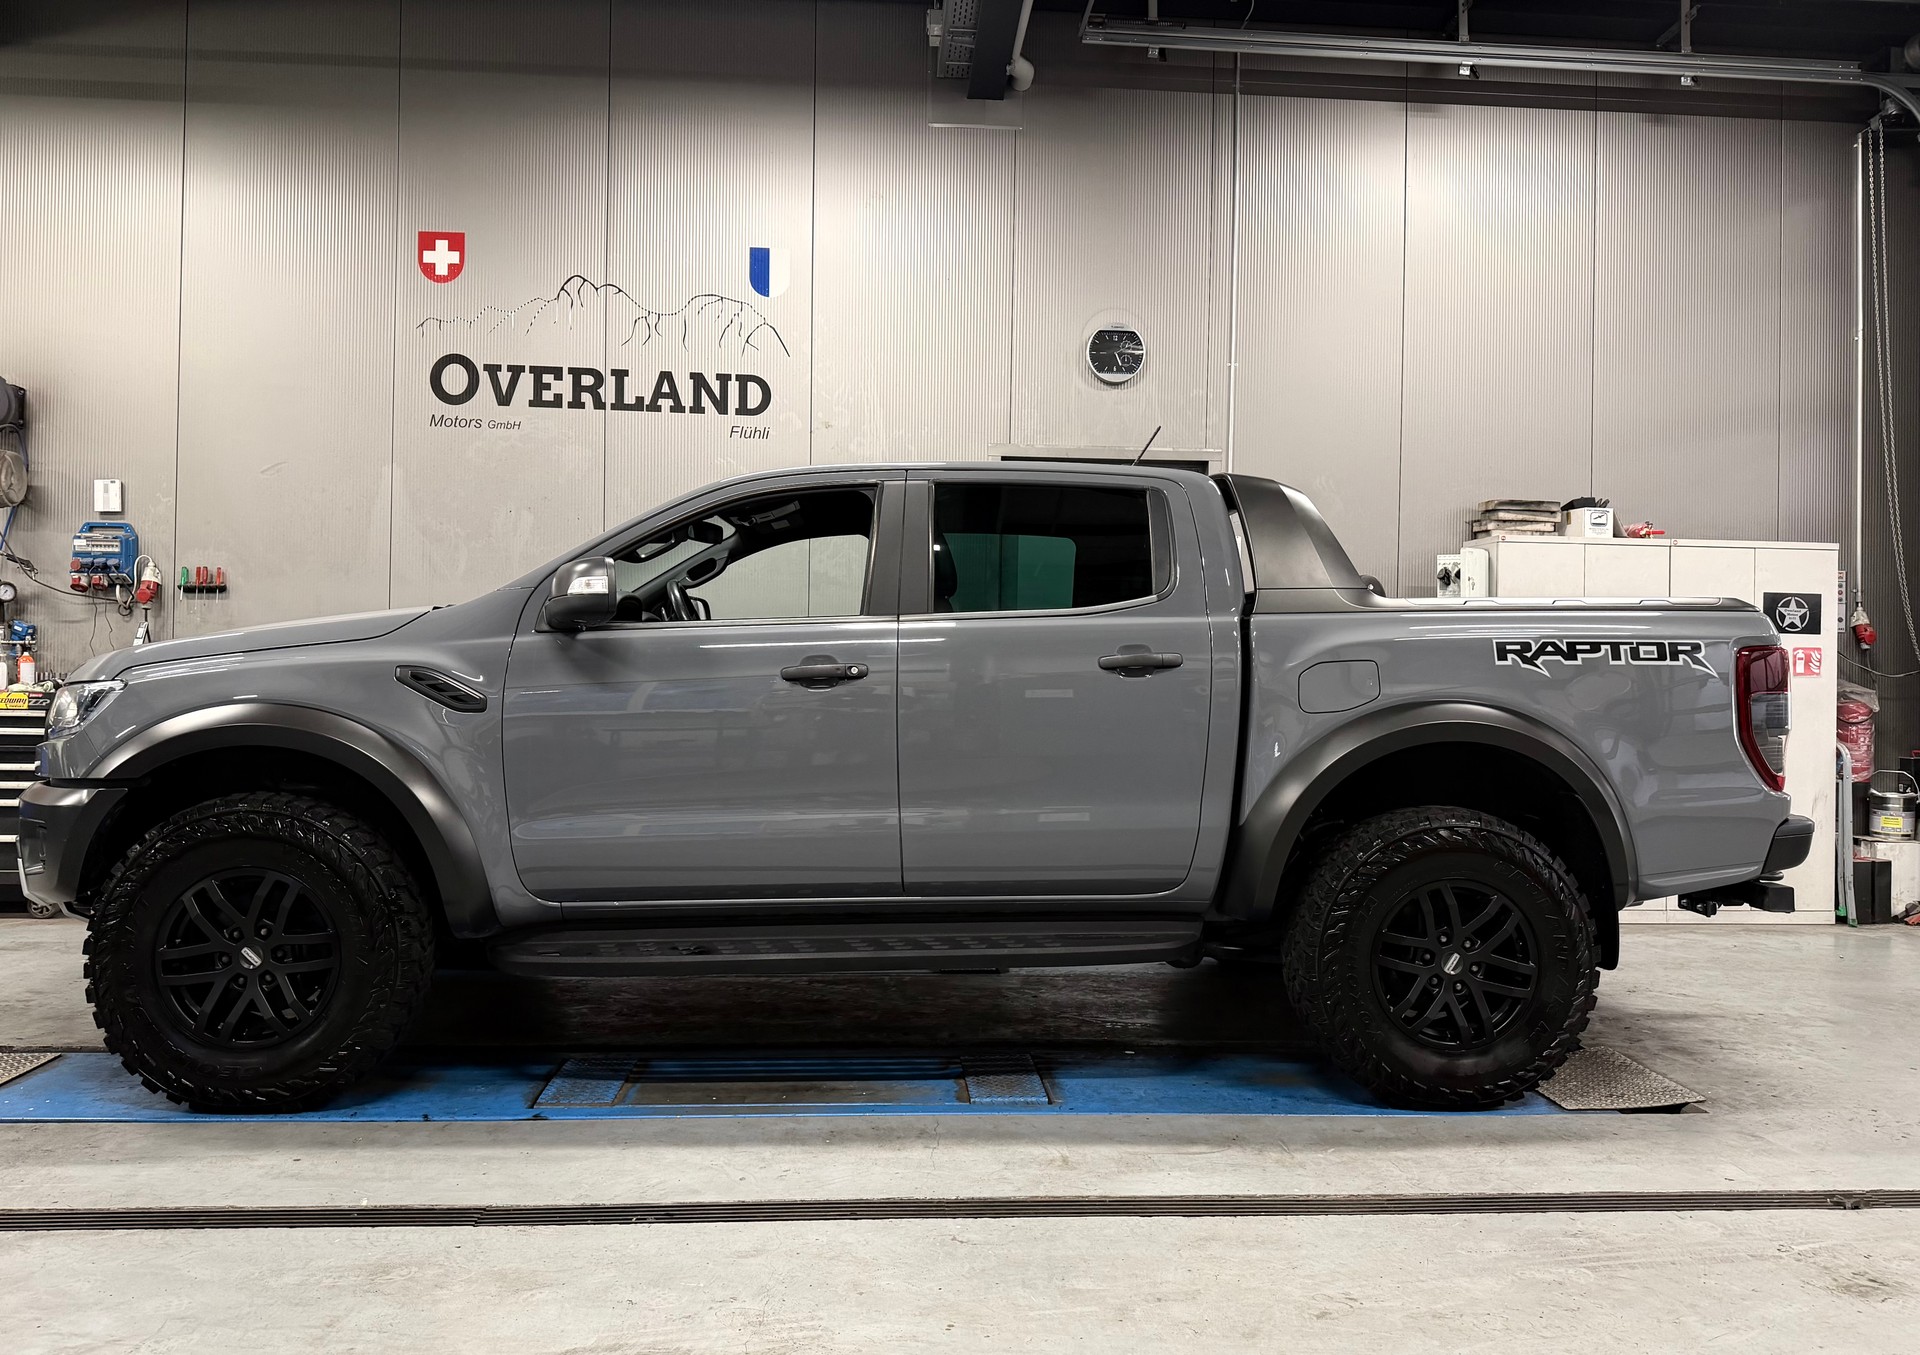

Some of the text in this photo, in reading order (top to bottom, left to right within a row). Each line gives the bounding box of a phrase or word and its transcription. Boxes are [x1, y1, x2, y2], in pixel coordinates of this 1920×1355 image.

[430, 353, 772, 417] OVERLAND
[429, 413, 522, 430] Motors GmbH
[729, 425, 771, 440] Flühli
[1492, 638, 1719, 679] RAPTOR
